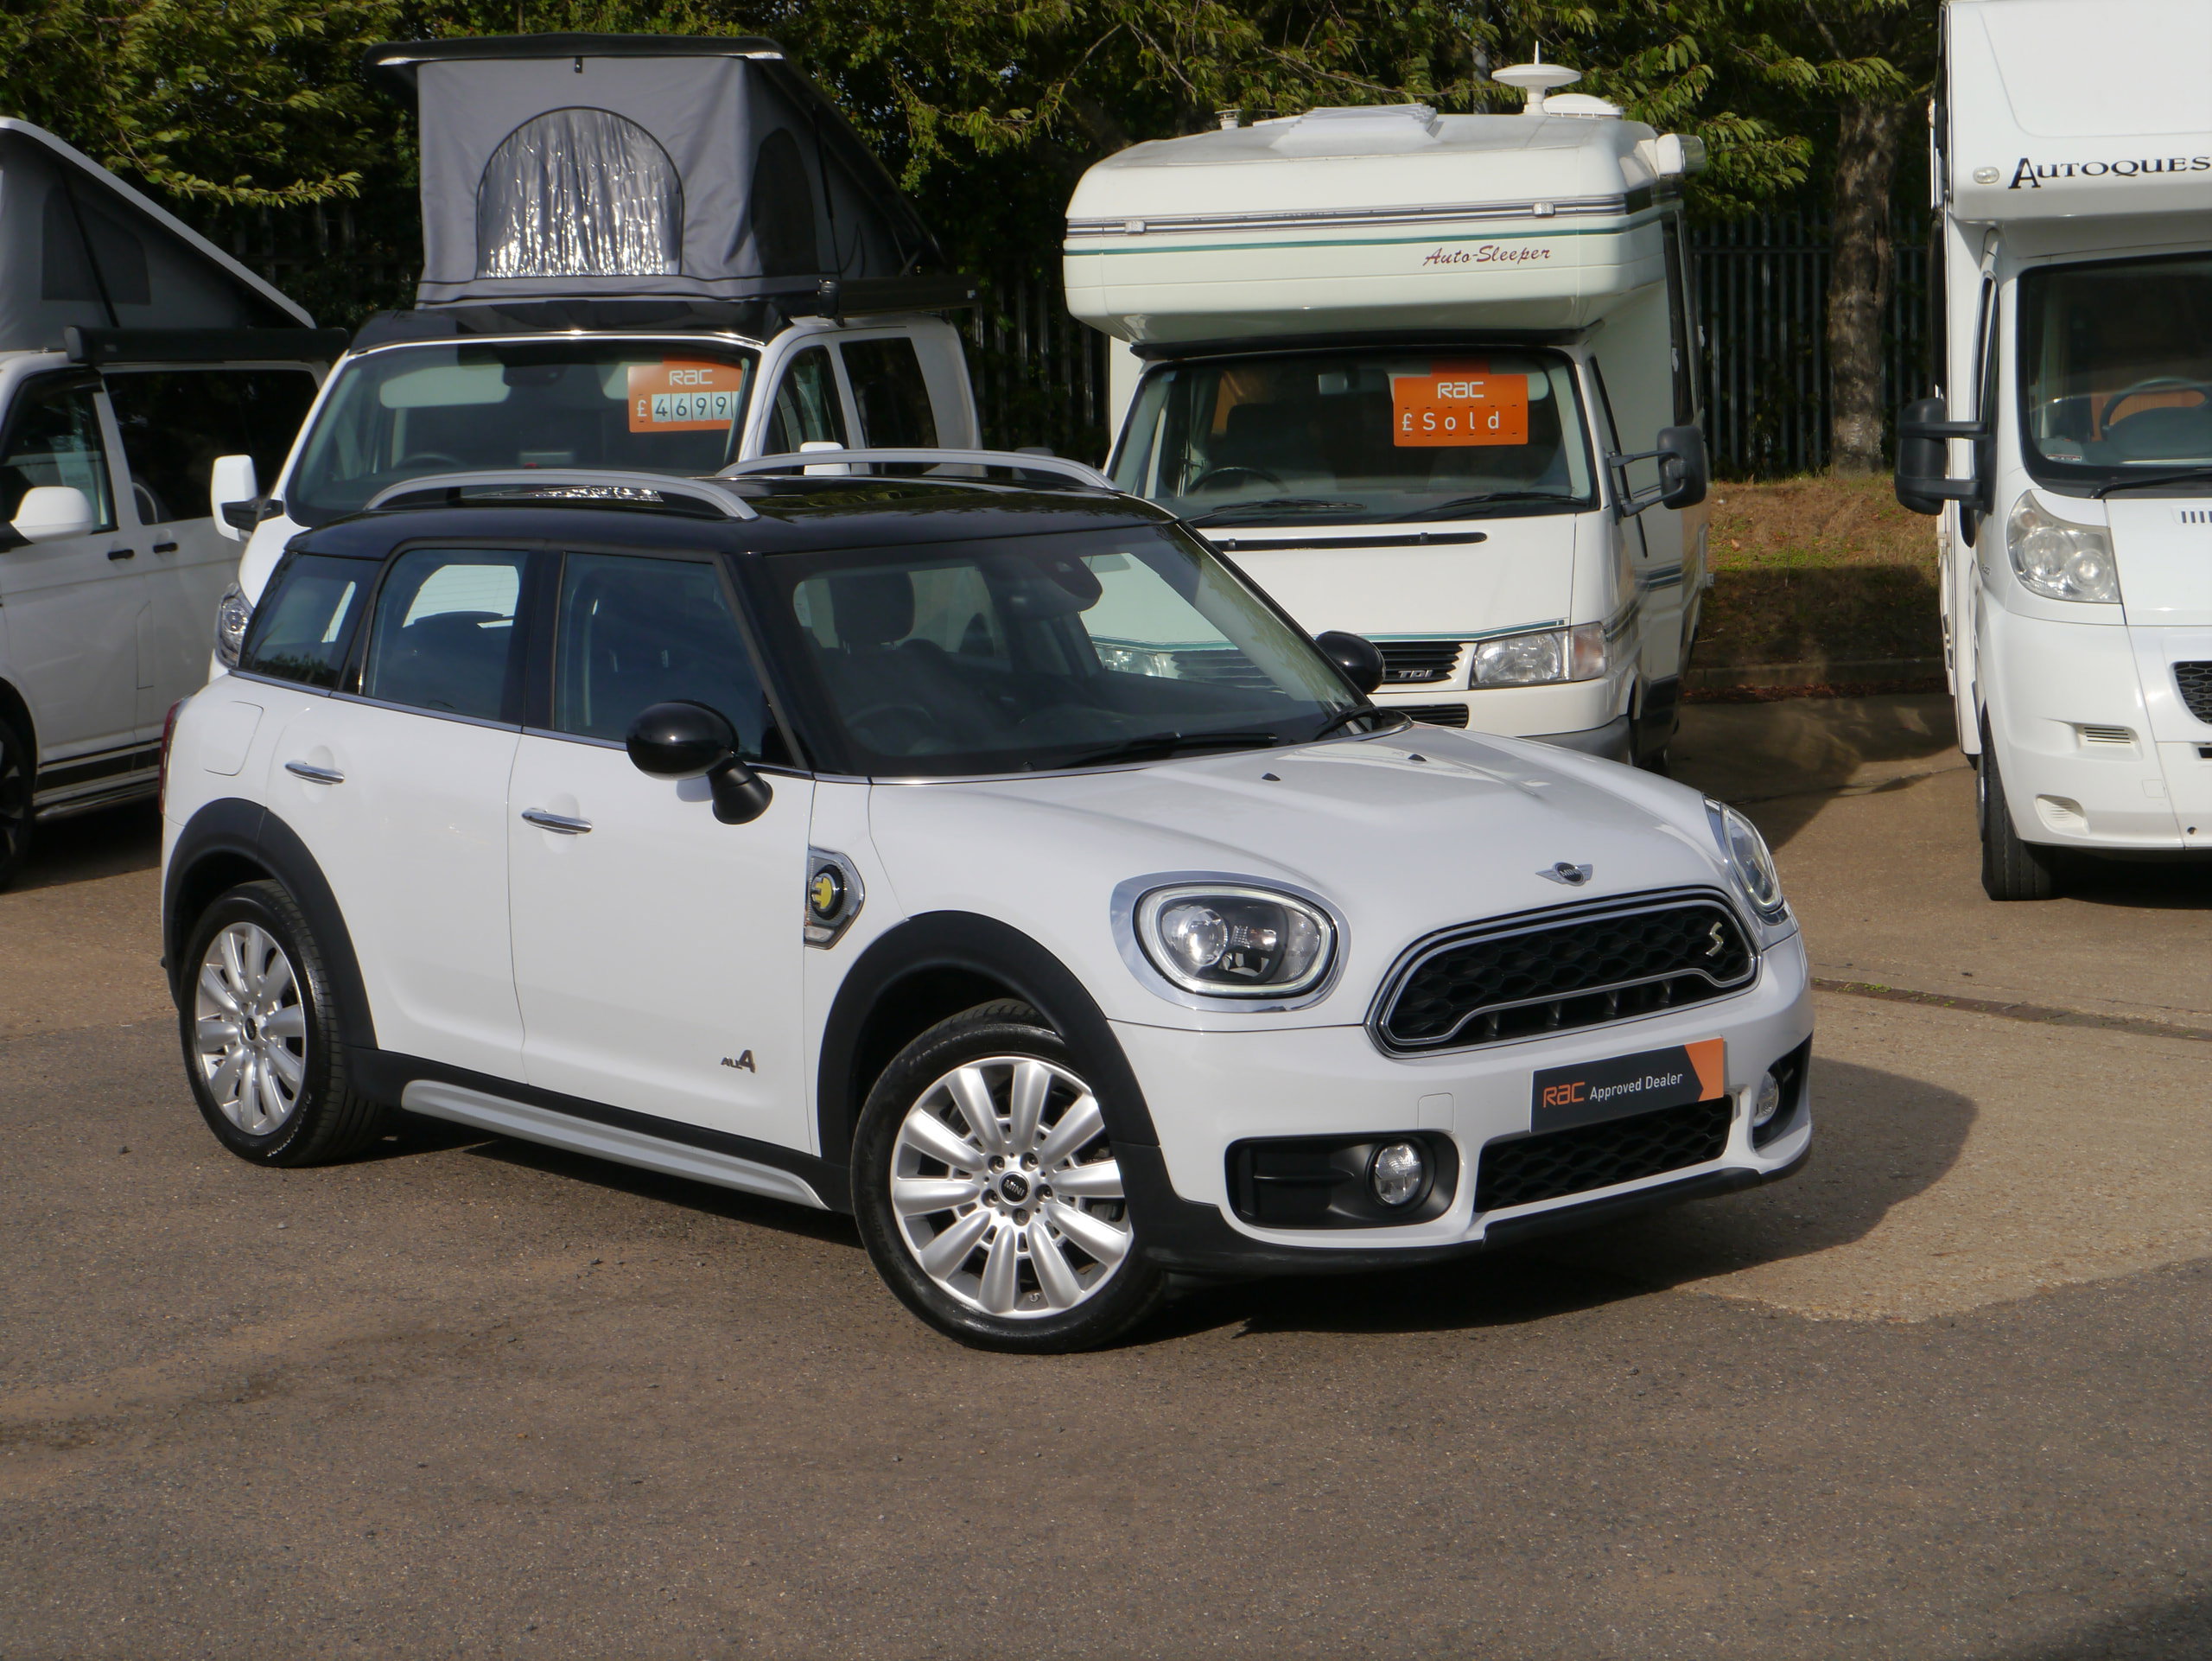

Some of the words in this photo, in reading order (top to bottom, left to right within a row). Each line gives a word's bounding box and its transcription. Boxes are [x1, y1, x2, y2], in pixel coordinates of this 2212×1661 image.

[1423, 245, 1550, 266] Auto-Sleeper
[636, 395, 732, 418] £4699
[1398, 669, 1433, 678] TDI
[1589, 1079, 1642, 1102] Approved
[1645, 1072, 1683, 1090] Dealer
[1004, 1179, 1025, 1197] MINI
